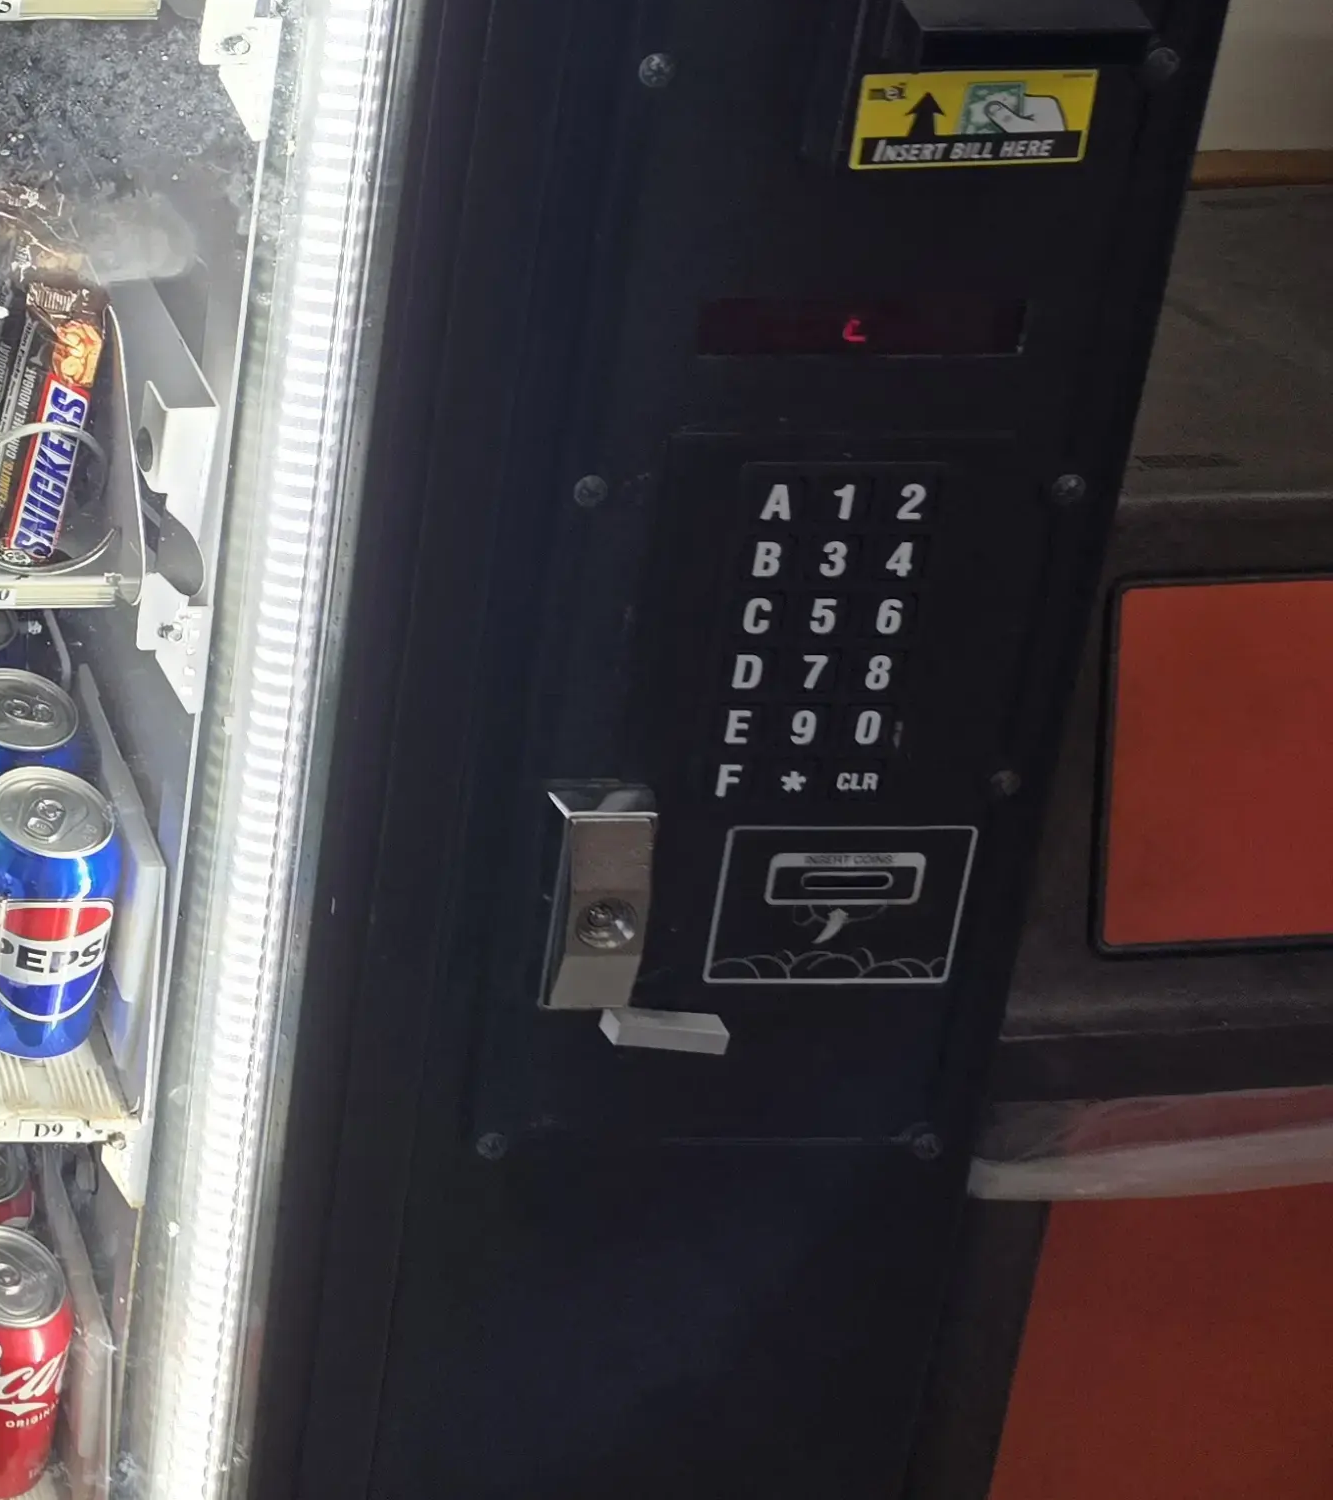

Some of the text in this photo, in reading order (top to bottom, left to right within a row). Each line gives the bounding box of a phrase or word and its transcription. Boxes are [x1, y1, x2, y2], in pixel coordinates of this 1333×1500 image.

[872, 137, 1055, 164] INSERT BILL HERE
[17, 367, 38, 408] NOUGAT
[759, 483, 927, 521] A 1 2
[752, 541, 914, 578] B 3 4
[742, 598, 904, 635] C 5 6
[731, 654, 892, 690] D 7 8
[724, 710, 882, 745] E 9 0
[714, 764, 878, 798] F CLR
[804, 853, 846, 866] INSERT
[0, 941, 107, 974] PEPS
[32, 1122, 64, 1137] D9
